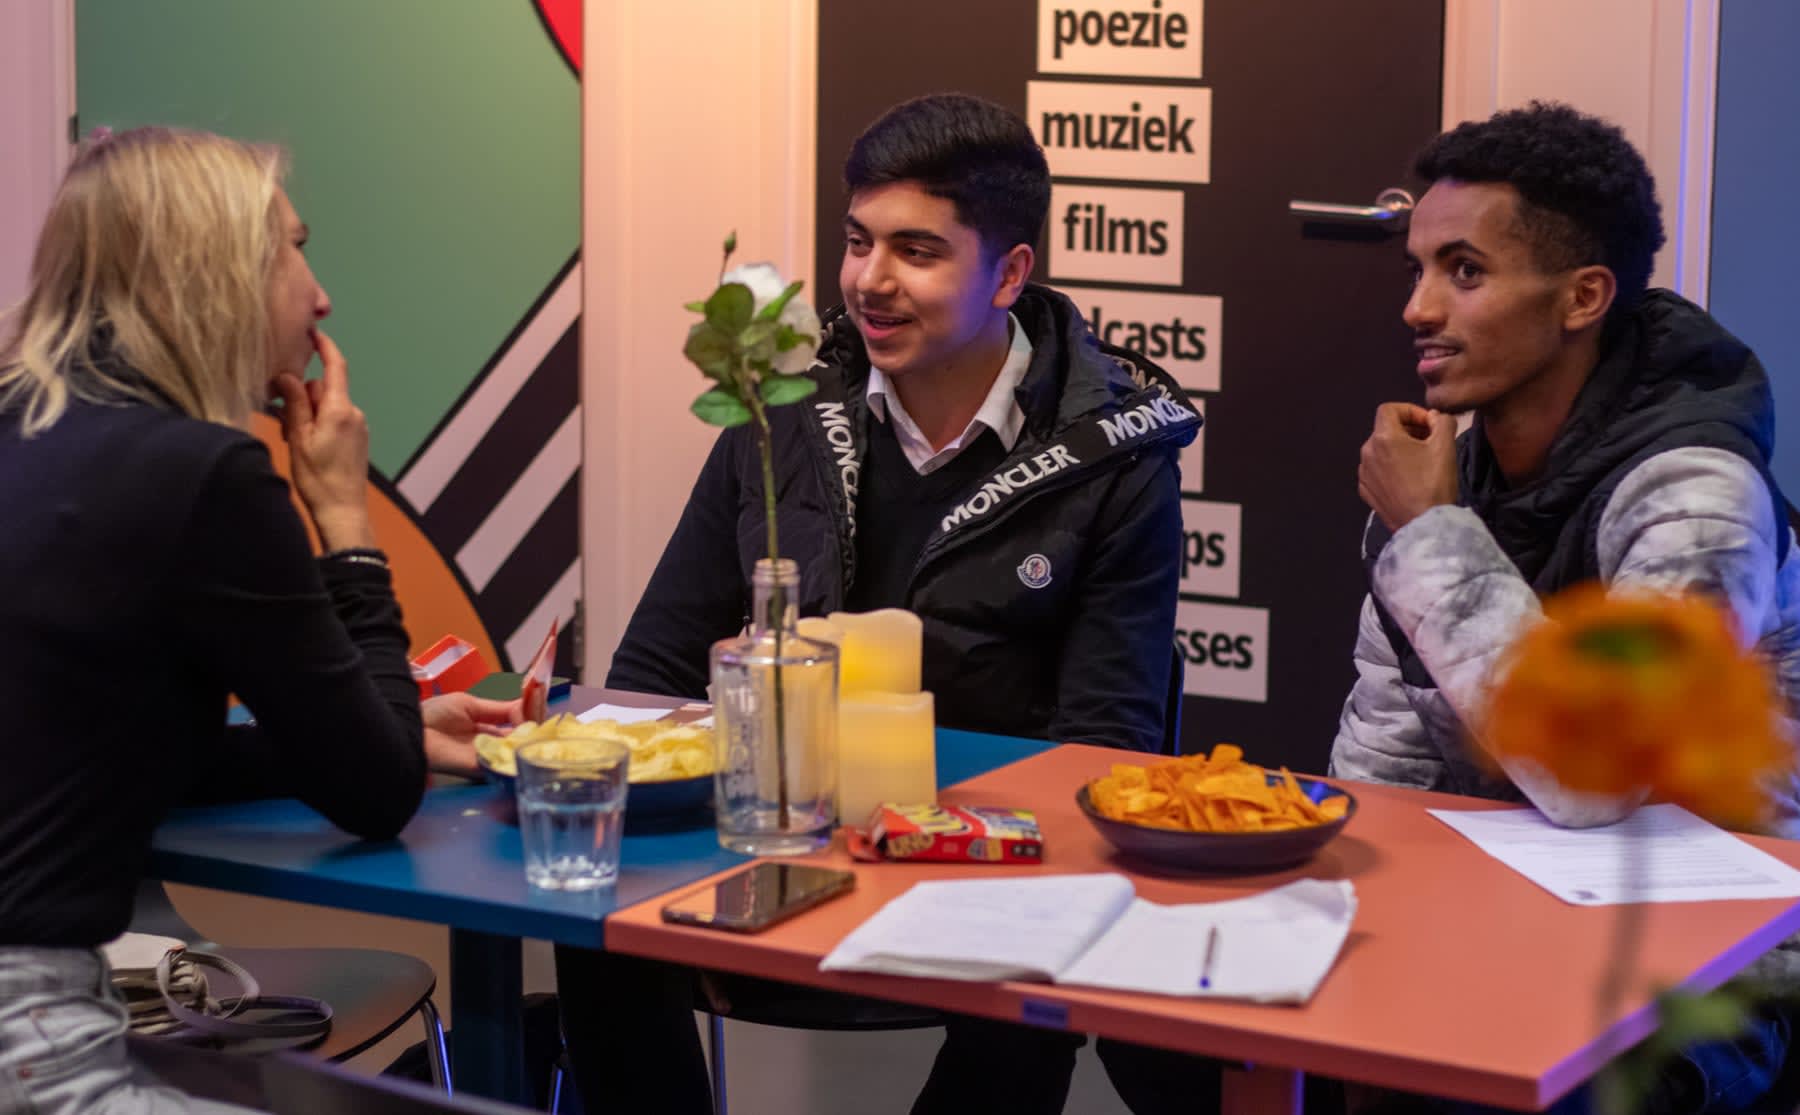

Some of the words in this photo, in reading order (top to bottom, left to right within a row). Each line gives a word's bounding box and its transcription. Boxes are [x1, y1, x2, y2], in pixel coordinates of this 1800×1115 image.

[1053, 0, 1189, 60] poezie
[1041, 101, 1196, 154] muziek
[1063, 203, 1170, 257] films
[941, 443, 1081, 532] MONCLER
